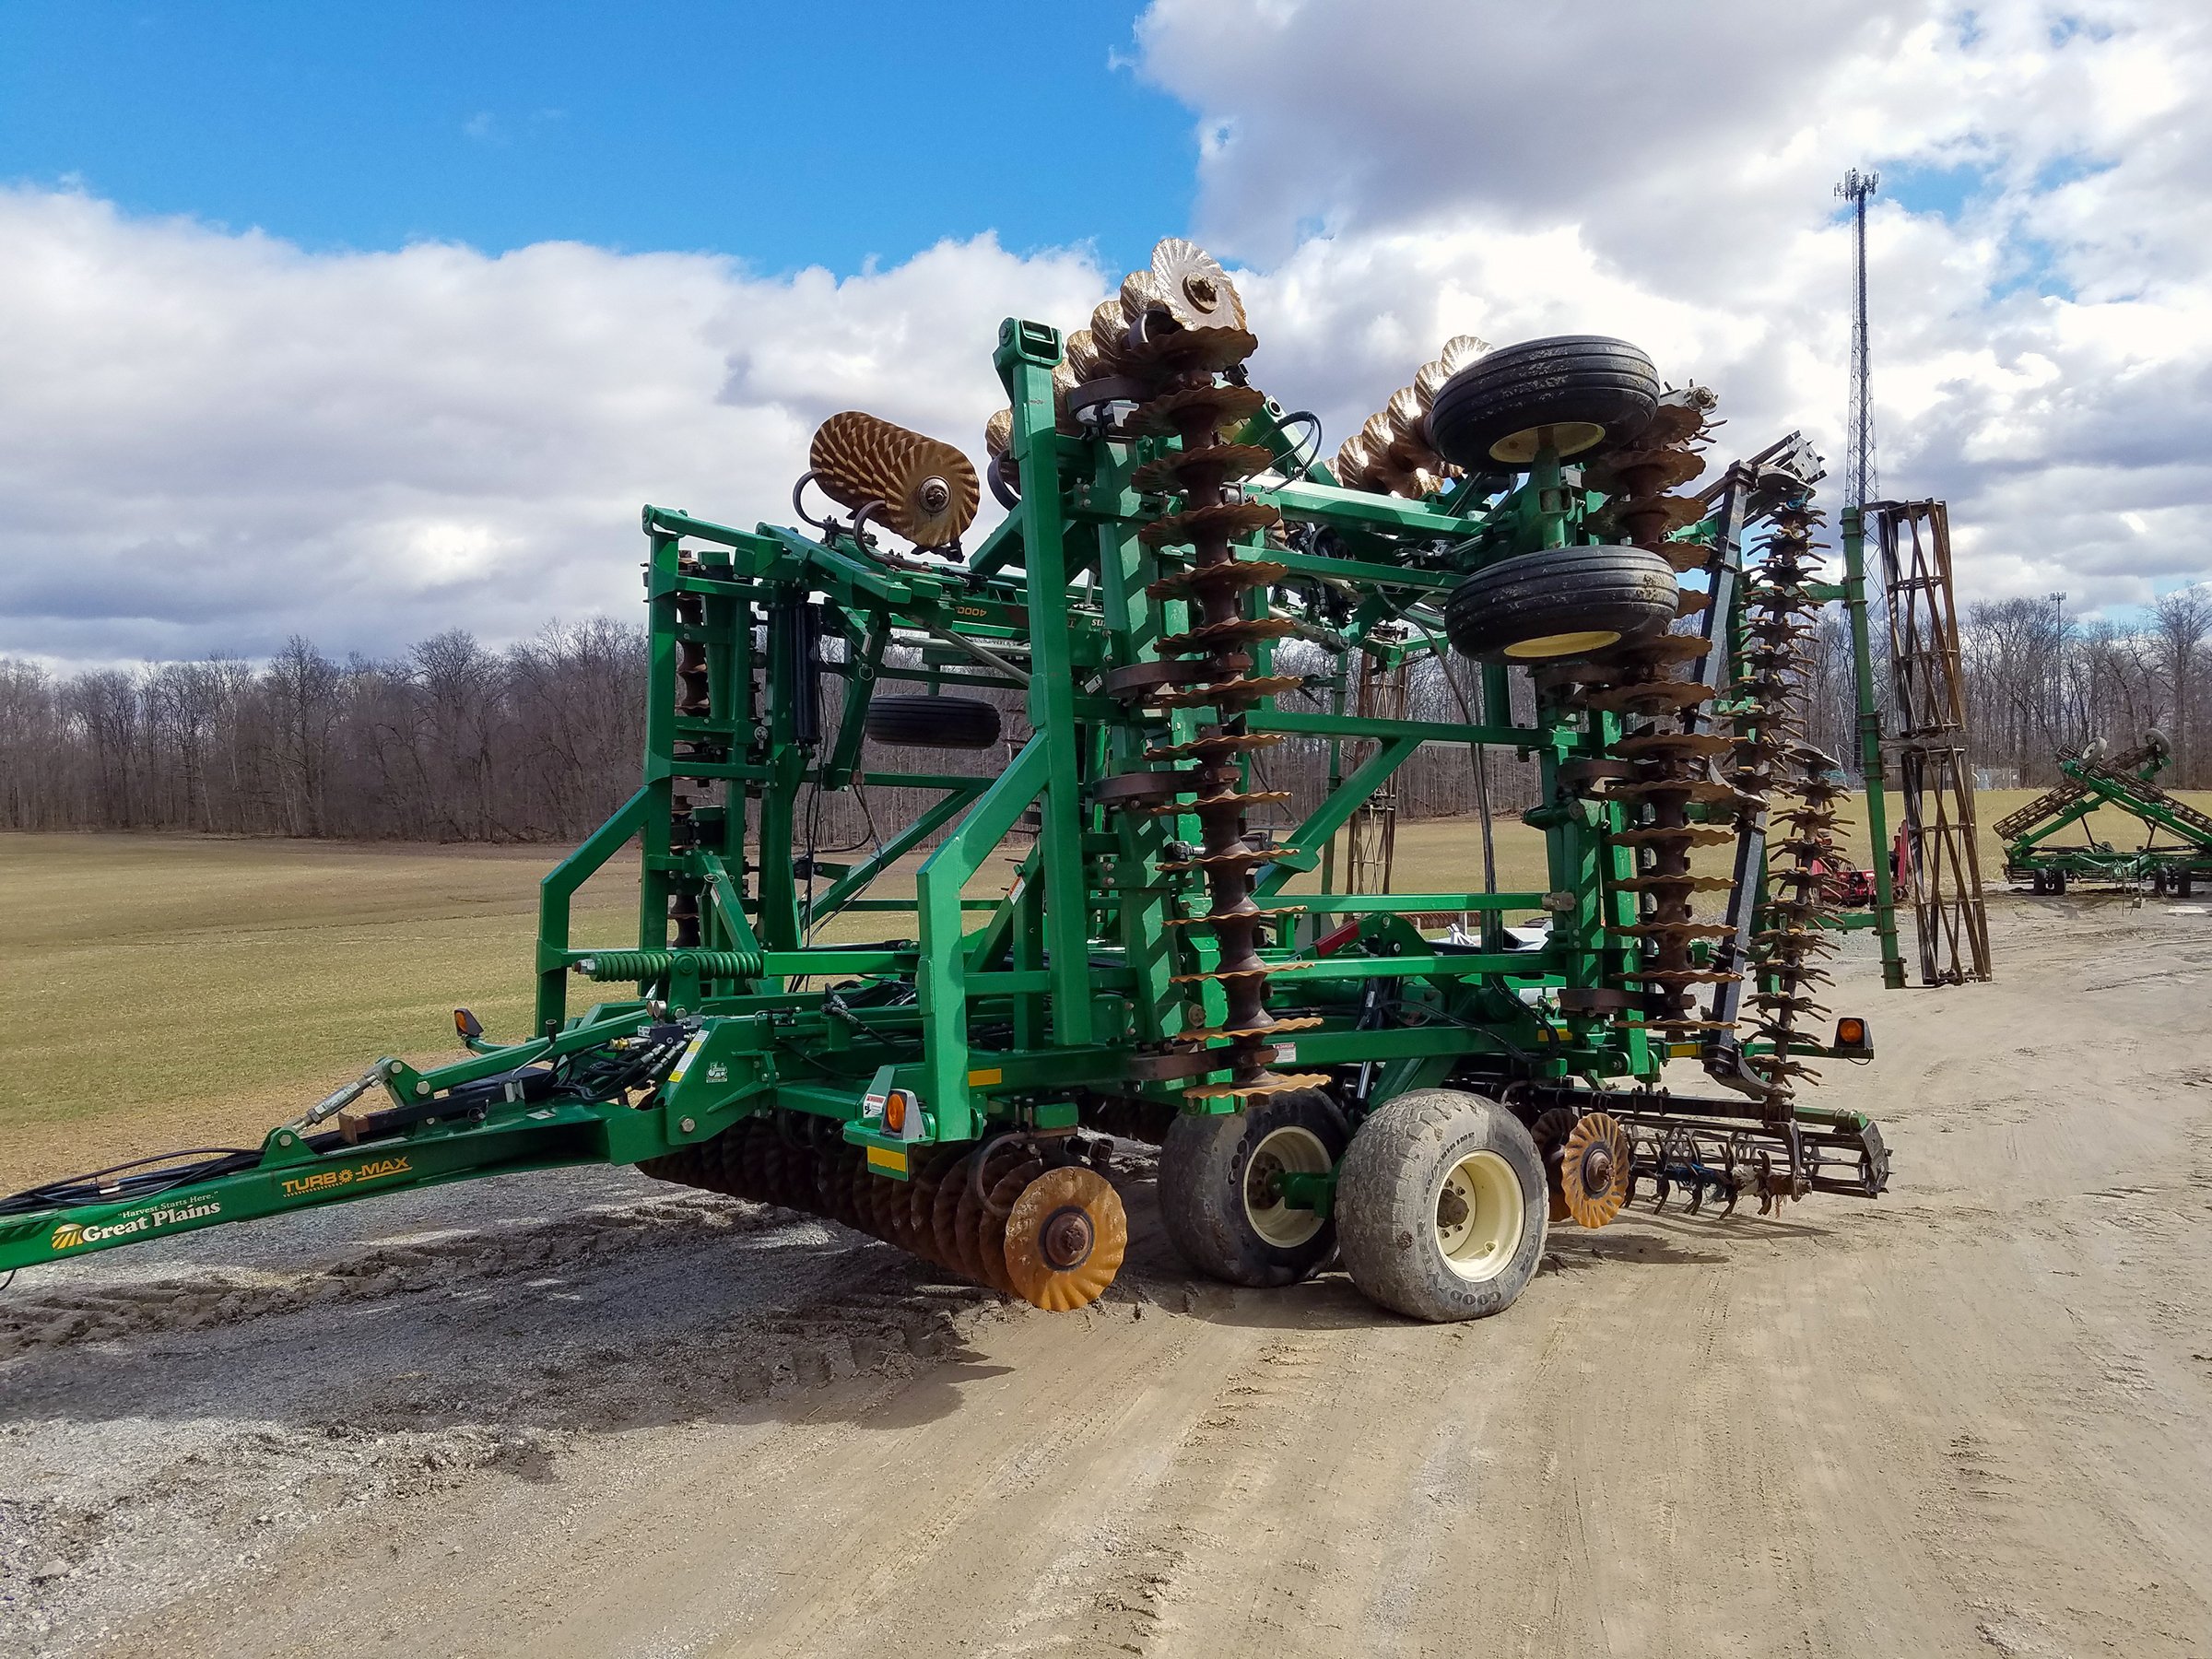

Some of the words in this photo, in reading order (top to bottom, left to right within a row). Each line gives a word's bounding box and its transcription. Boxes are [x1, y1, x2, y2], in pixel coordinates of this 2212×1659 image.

[160, 1200, 187, 1210] Starts
[82, 1217, 148, 1242] Great
[152, 1202, 221, 1228] Plains
